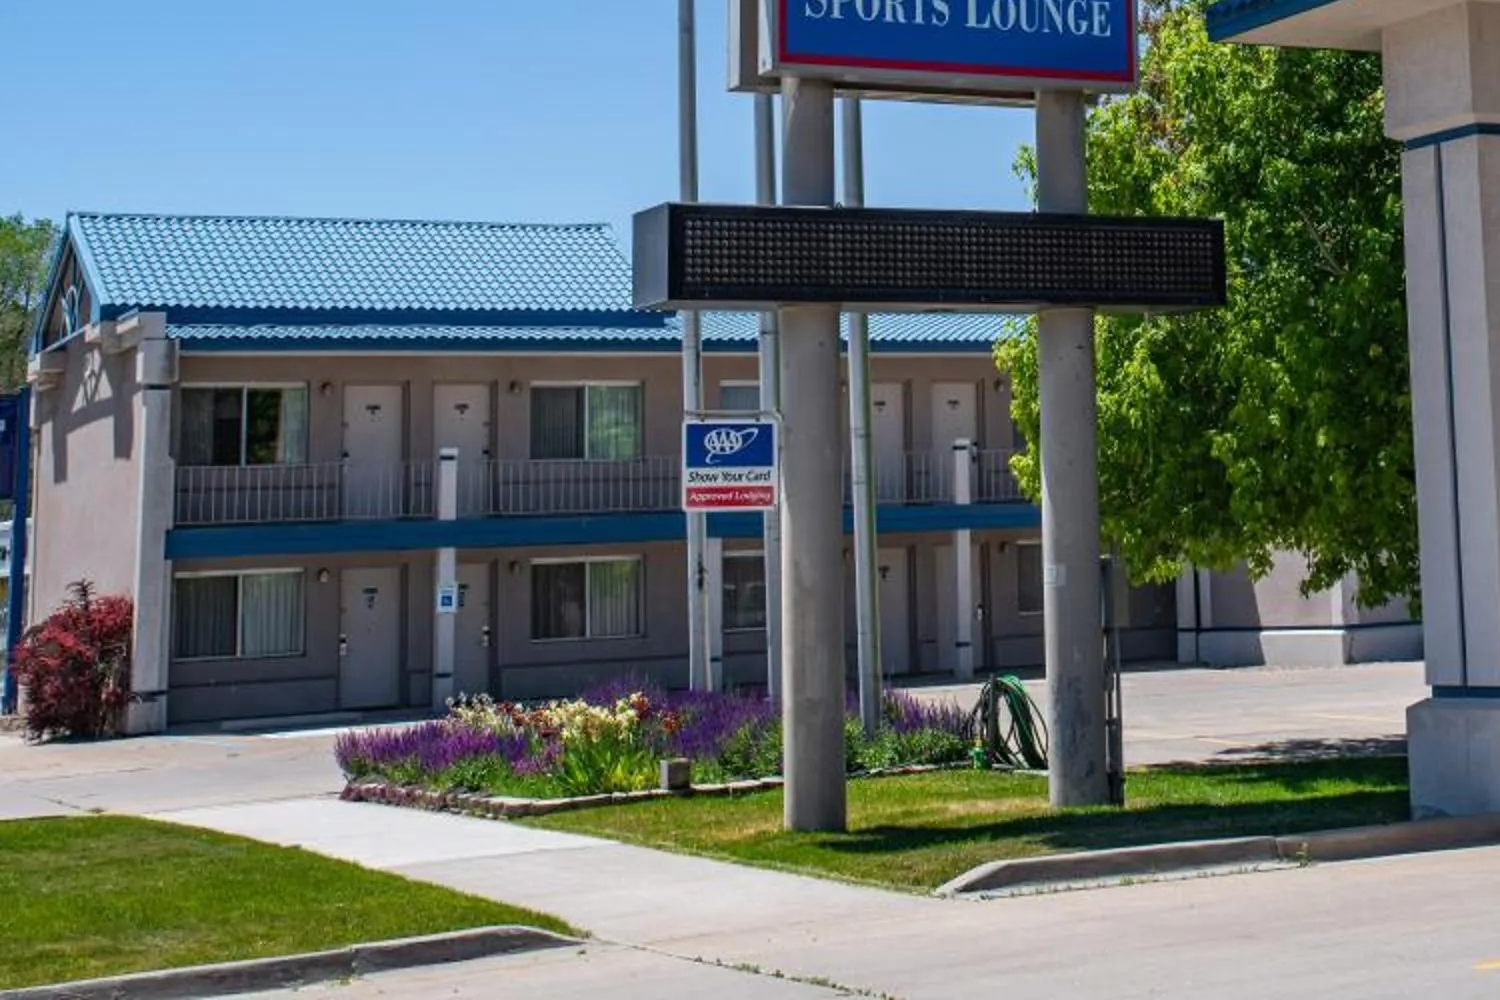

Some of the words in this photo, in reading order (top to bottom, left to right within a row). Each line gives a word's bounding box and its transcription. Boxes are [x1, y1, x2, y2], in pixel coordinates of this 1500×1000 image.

[706, 429, 741, 453] AAA
[688, 471, 719, 483] Show
[746, 470, 771, 481] Card
